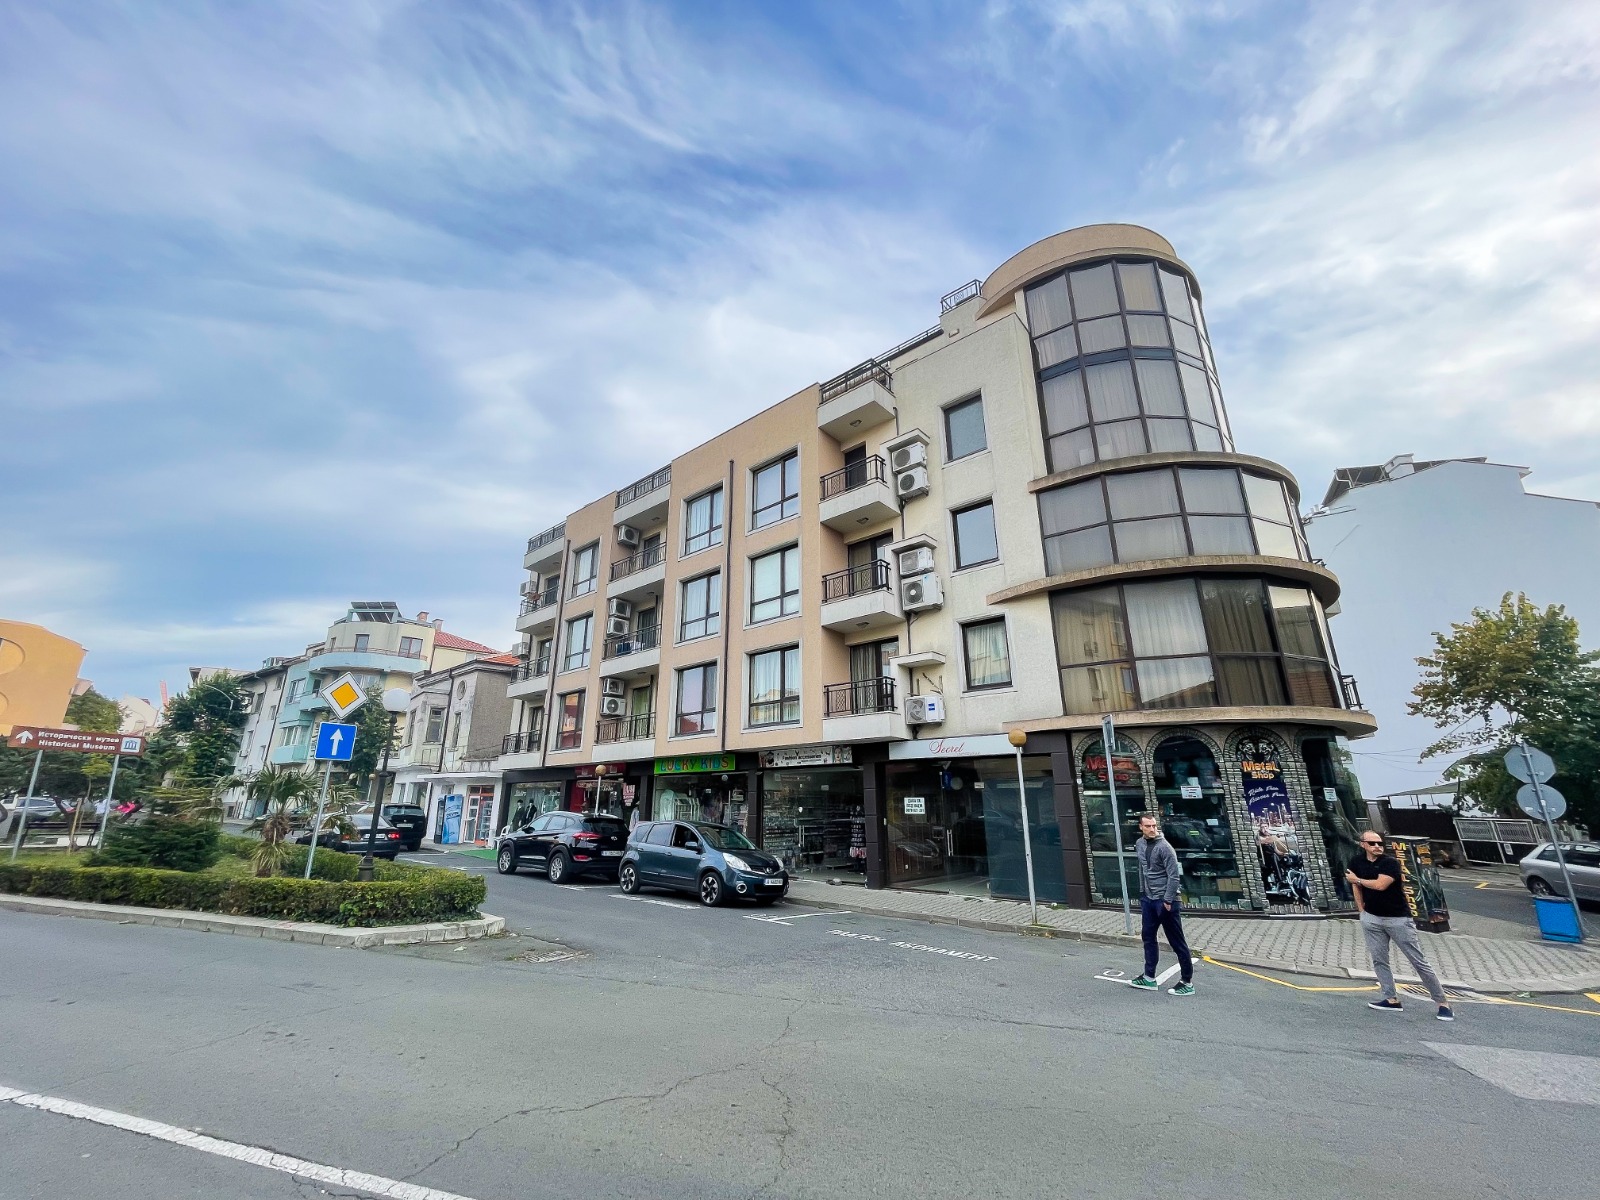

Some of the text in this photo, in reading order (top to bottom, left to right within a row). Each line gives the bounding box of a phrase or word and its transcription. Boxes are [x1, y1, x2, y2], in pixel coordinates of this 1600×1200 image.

[38, 731, 92, 741] Исторически
[39, 740, 115, 750] Historical Museum
[929, 740, 965, 754] Secret
[661, 756, 728, 771] LUCKY KIDS
[1242, 761, 1280, 772] Metal
[1251, 771, 1274, 779] Shop
